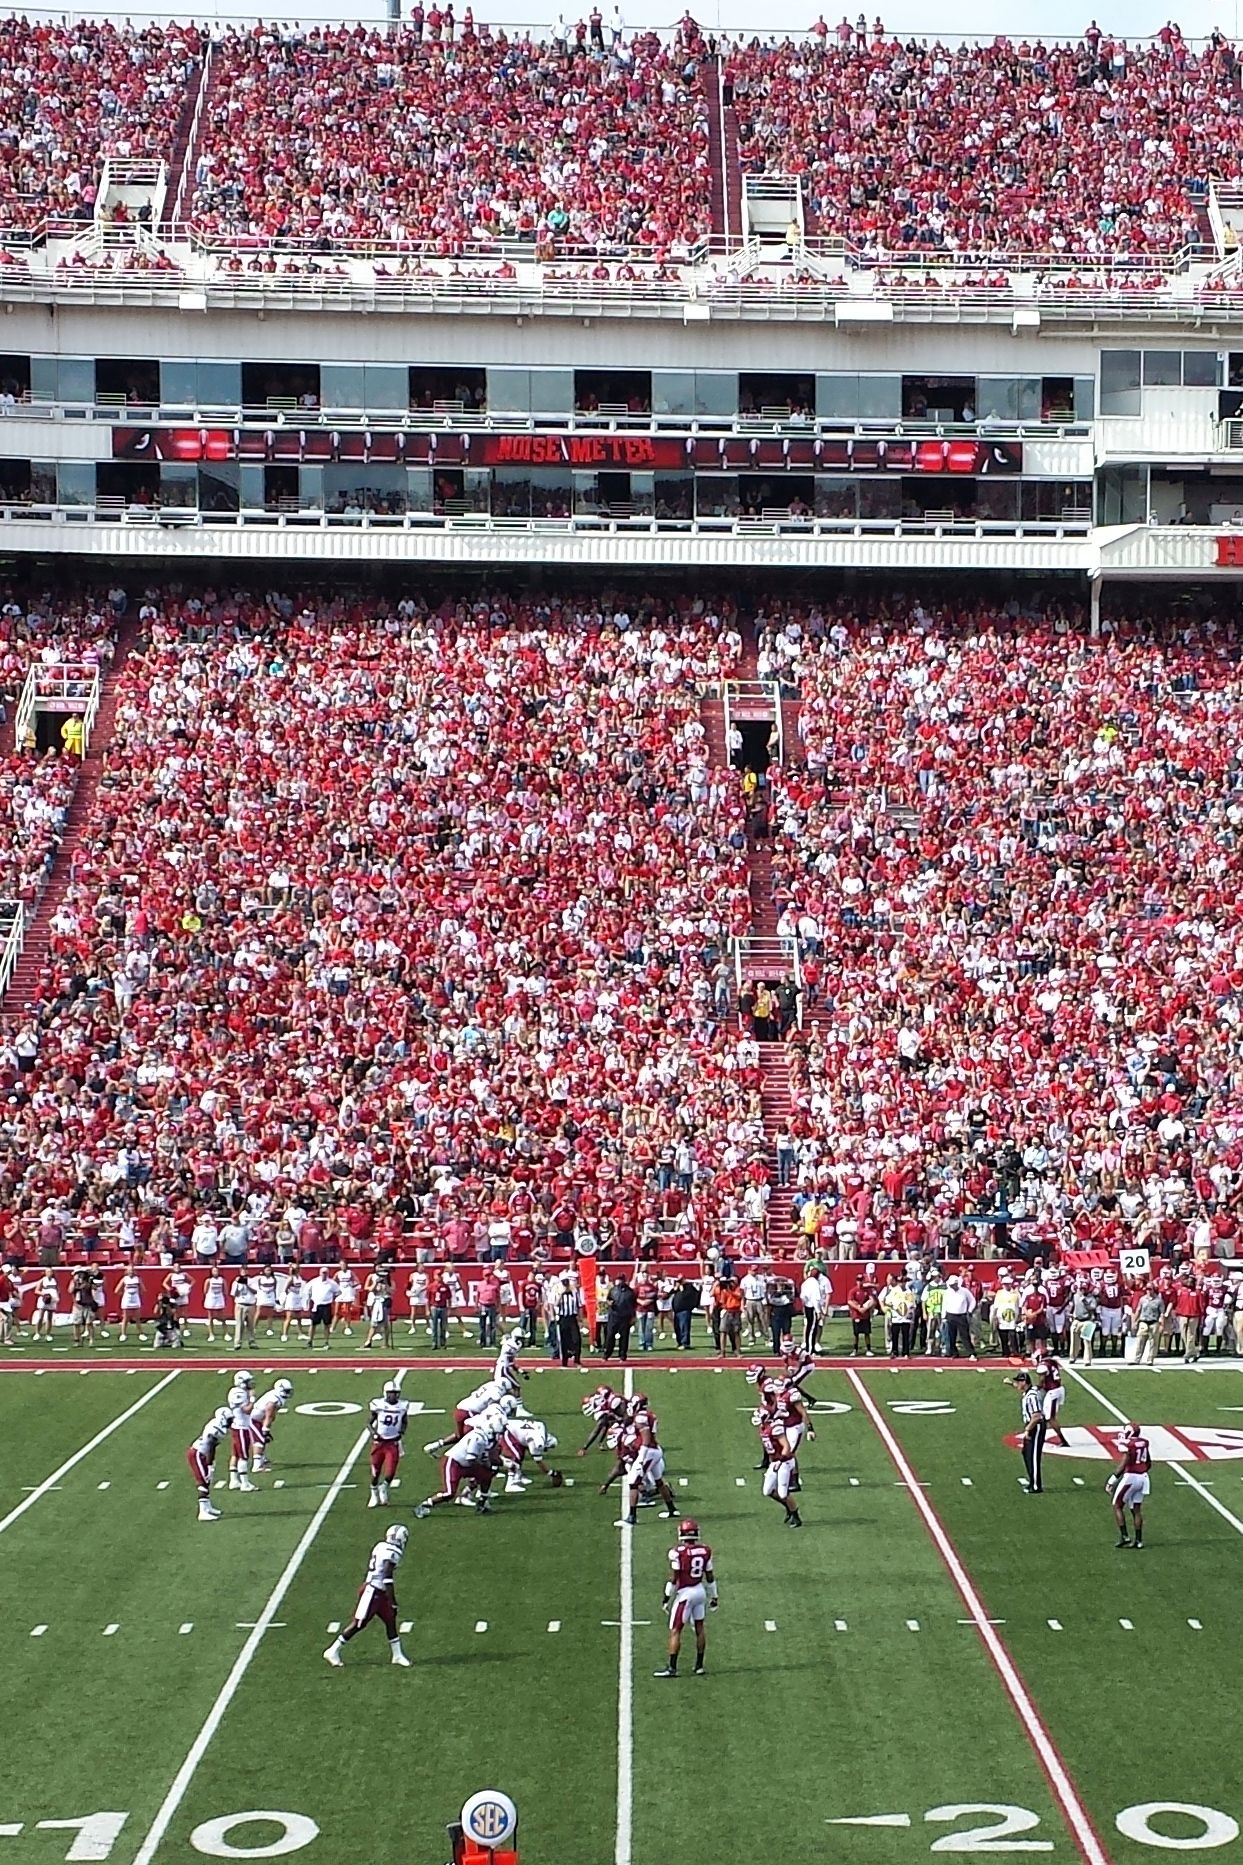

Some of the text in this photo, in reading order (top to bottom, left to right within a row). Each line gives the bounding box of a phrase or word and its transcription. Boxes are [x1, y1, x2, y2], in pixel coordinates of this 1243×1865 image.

[498, 436, 655, 464] NOISE METER
[1125, 1255, 1145, 1268] 20
[690, 1556, 704, 1578] 8
[470, 1802, 508, 1838] SEC
